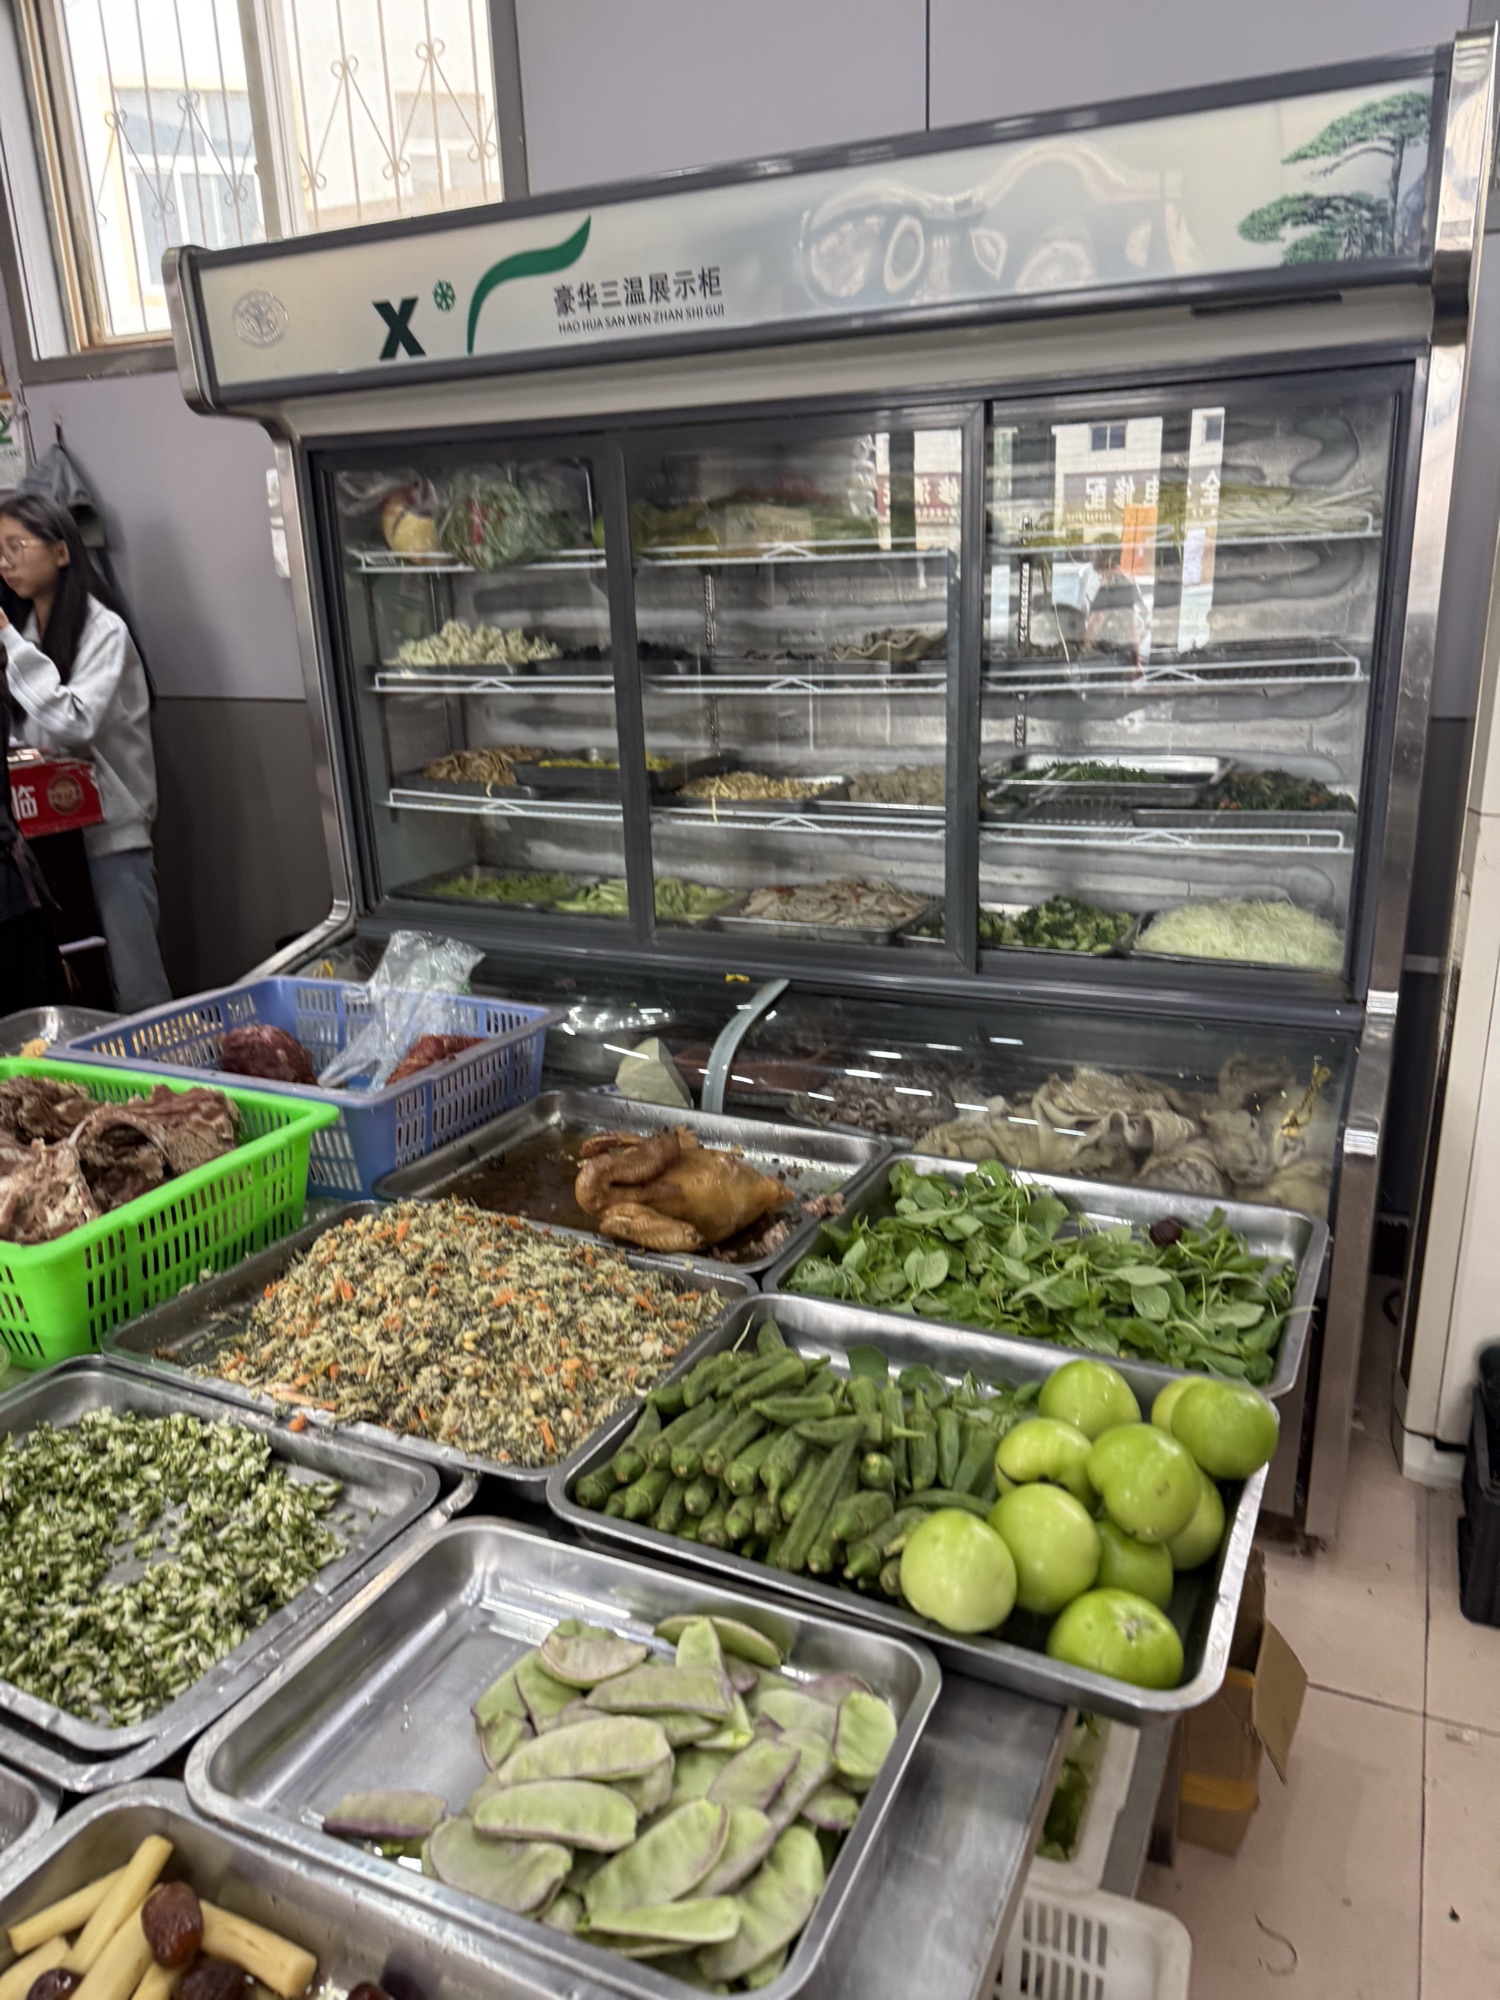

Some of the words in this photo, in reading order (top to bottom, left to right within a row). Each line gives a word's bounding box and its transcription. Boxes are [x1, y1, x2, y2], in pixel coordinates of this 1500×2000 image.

[553, 266, 723, 318] 豪华三温展示柜
[372, 296, 427, 361] X
[558, 320, 581, 335] HAO
[582, 318, 604, 333] HUA
[605, 315, 626, 329] SAN
[627, 312, 651, 327] WEN
[653, 309, 684, 323] ZHAN
[685, 305, 704, 320] SHI
[705, 303, 725, 317] GUI
